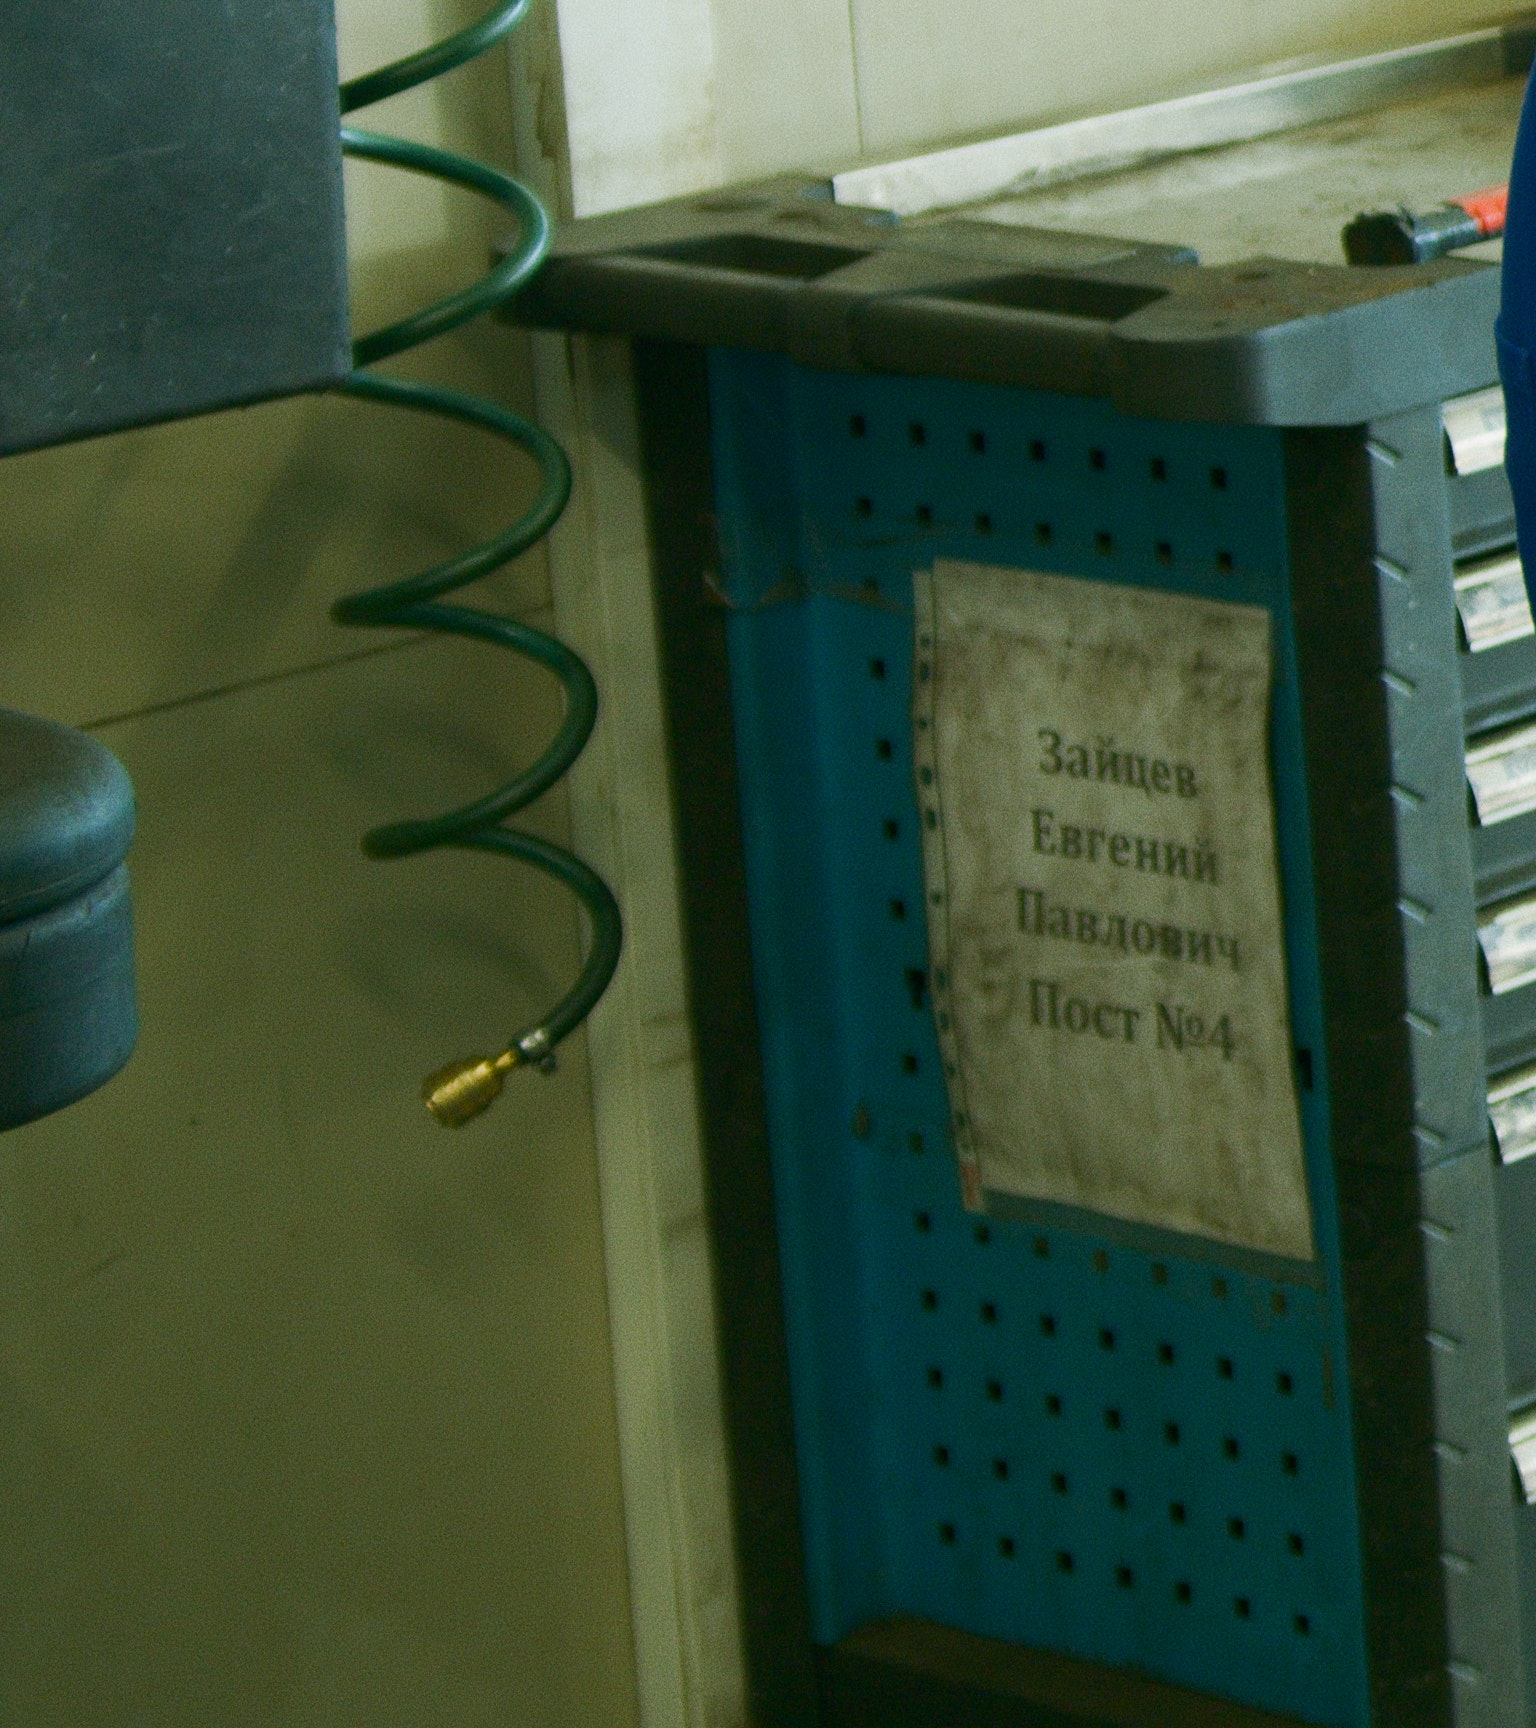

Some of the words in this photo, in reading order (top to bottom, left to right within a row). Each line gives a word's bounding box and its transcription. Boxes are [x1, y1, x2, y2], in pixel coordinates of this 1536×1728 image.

[1037, 727, 1200, 799] Зайцев
[1030, 807, 1220, 885] Евгений
[1015, 886, 1240, 971] Павлович
[1029, 977, 1140, 1044] Пост
